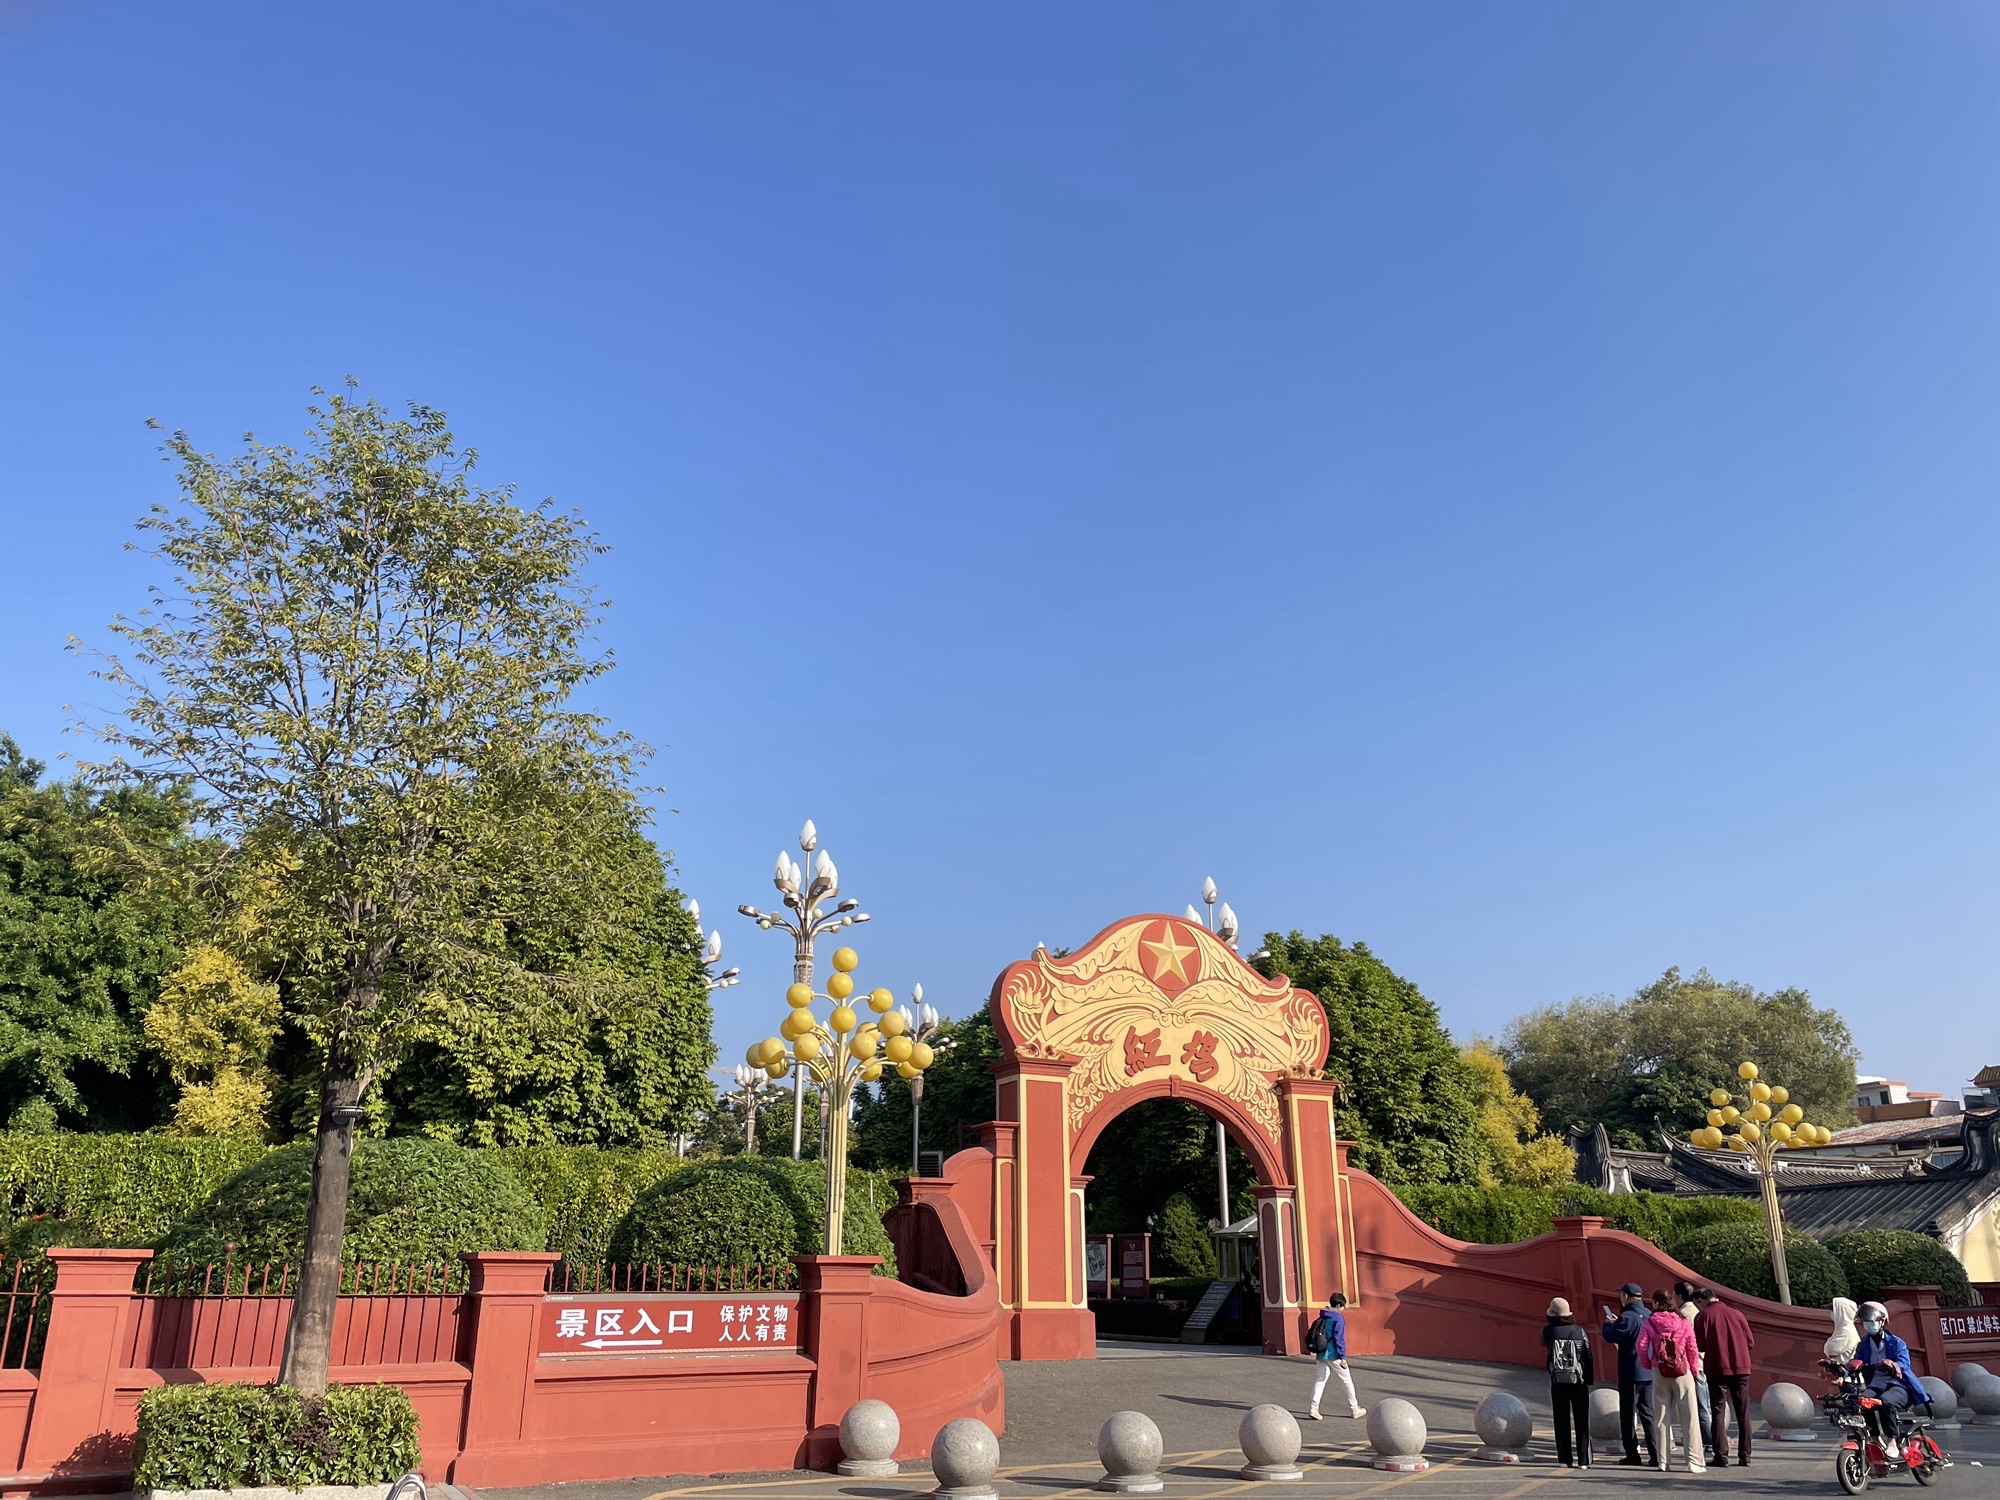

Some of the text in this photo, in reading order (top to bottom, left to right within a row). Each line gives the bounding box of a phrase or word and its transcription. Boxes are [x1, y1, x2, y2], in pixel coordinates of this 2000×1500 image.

[555, 1308, 694, 1338] 景区入口
[719, 1305, 789, 1323] 保护文物
[718, 1324, 787, 1342] 人人有责
